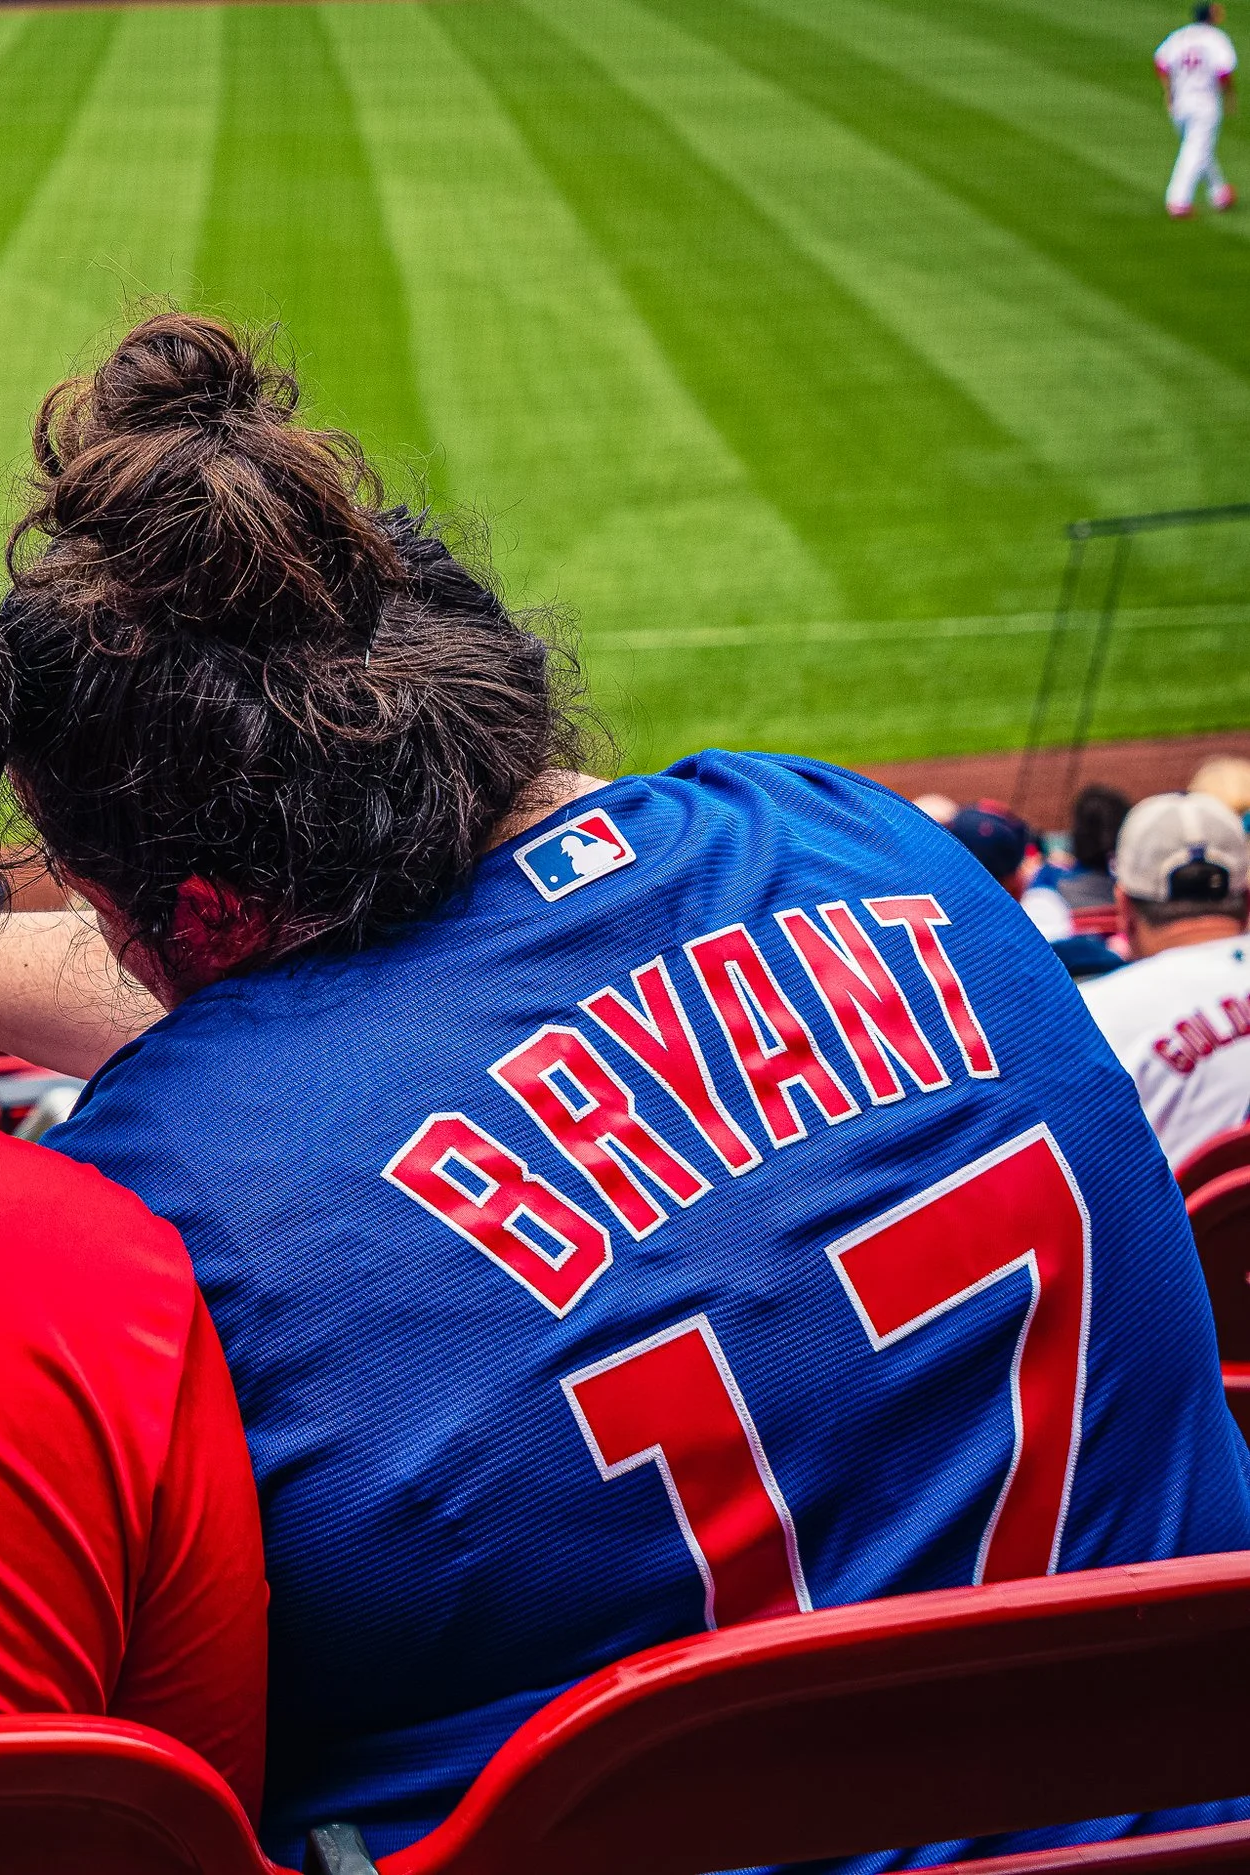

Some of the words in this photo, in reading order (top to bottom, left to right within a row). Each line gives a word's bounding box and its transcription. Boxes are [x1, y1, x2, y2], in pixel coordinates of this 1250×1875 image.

[381, 895, 1000, 1319] BRYANT
[1152, 990, 1250, 1075] GOLD
[559, 1123, 1091, 1630] 17
